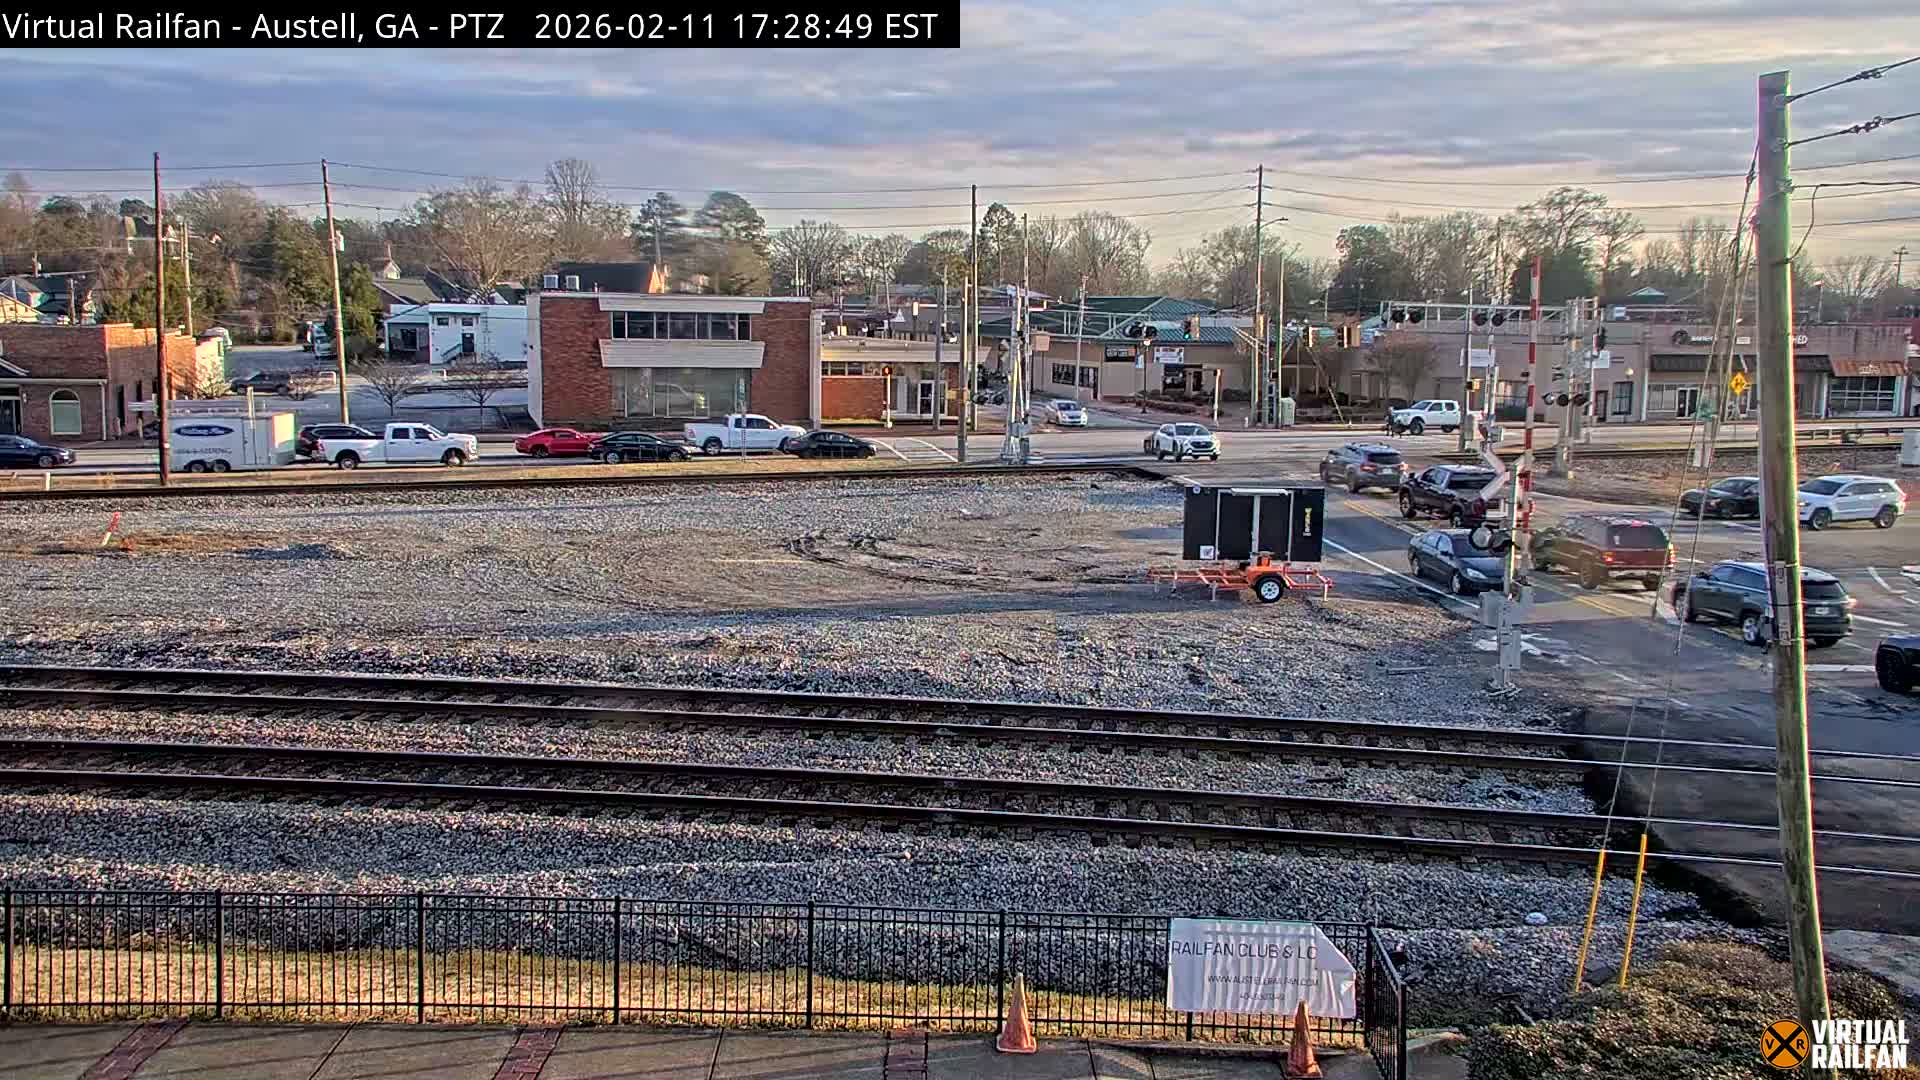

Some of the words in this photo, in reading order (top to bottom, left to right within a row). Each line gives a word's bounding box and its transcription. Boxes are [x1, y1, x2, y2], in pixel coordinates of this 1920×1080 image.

[1171, 941, 1234, 957] RAILFAN
[1238, 943, 1279, 958] CLUB
[1282, 945, 1293, 960] &
